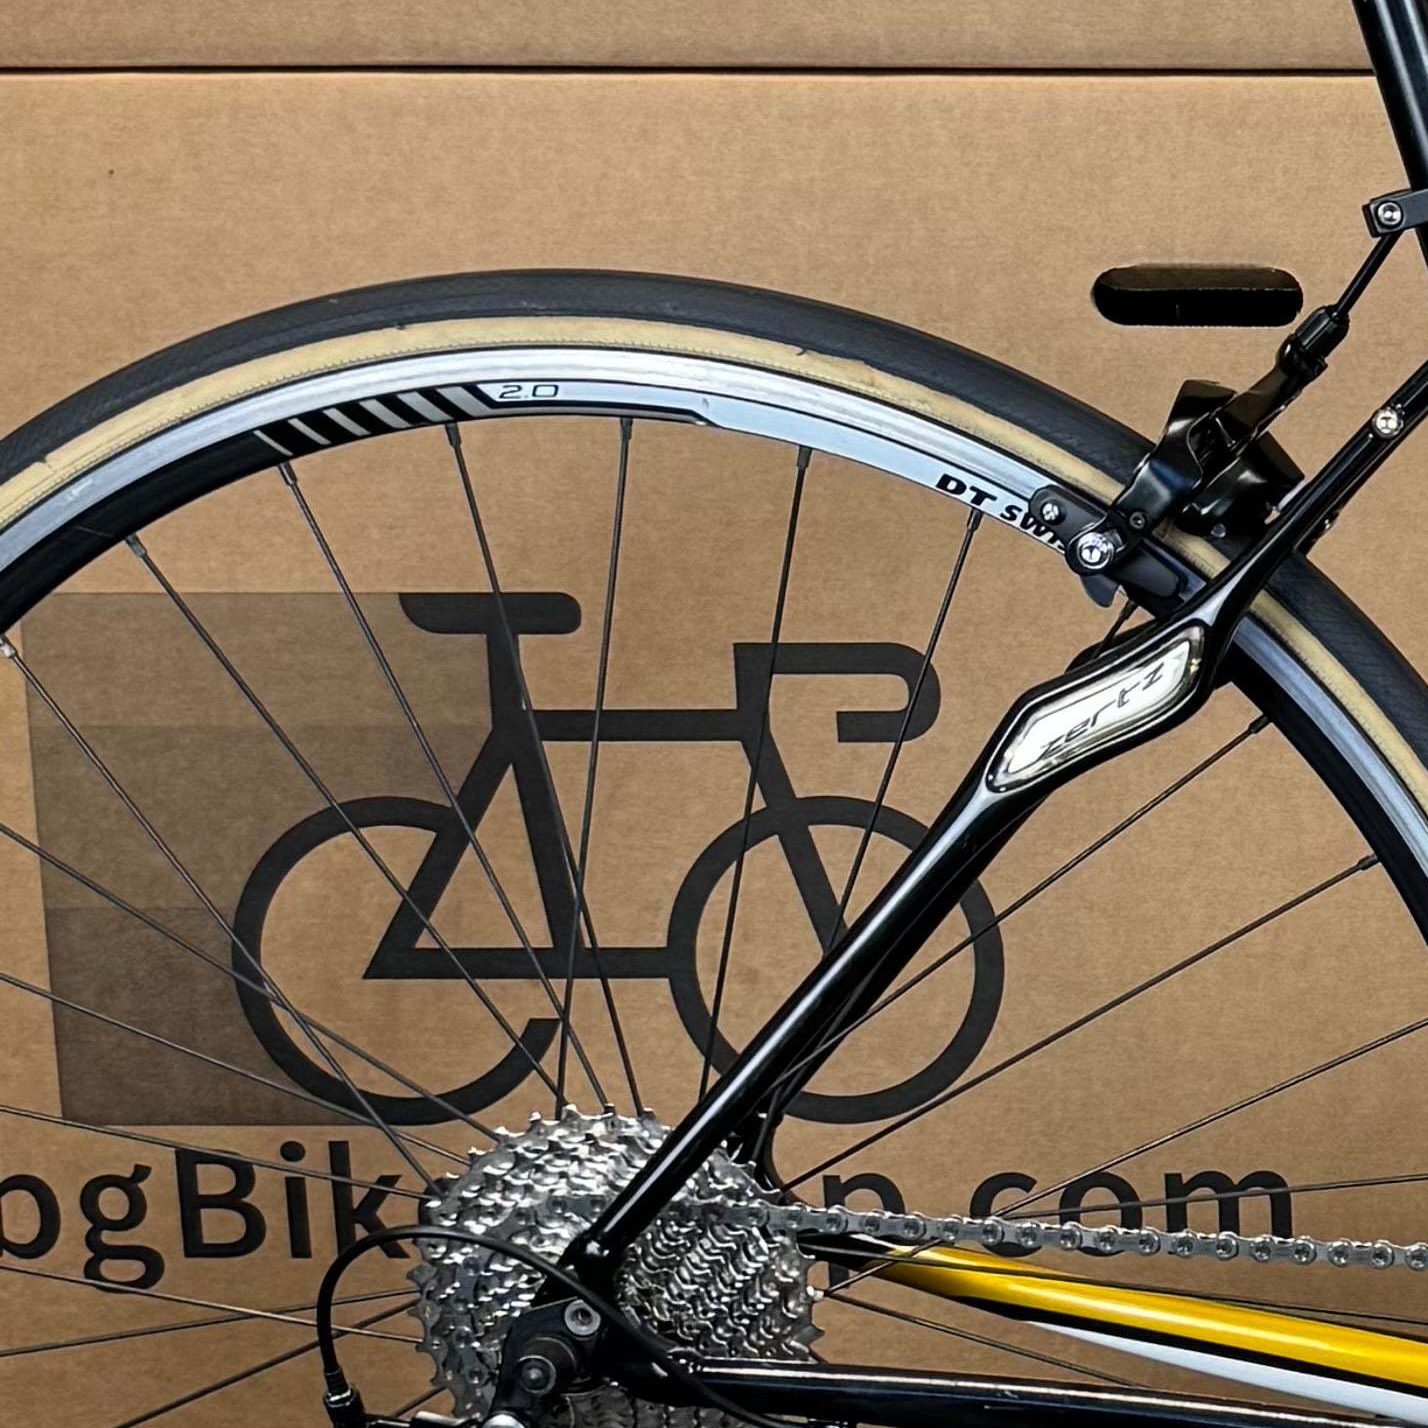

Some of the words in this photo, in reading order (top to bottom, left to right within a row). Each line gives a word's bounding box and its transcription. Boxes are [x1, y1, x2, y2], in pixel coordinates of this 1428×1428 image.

[499, 383, 560, 400] 2.0
[935, 473, 998, 507] DT
[1000, 504, 1066, 555] SWI
